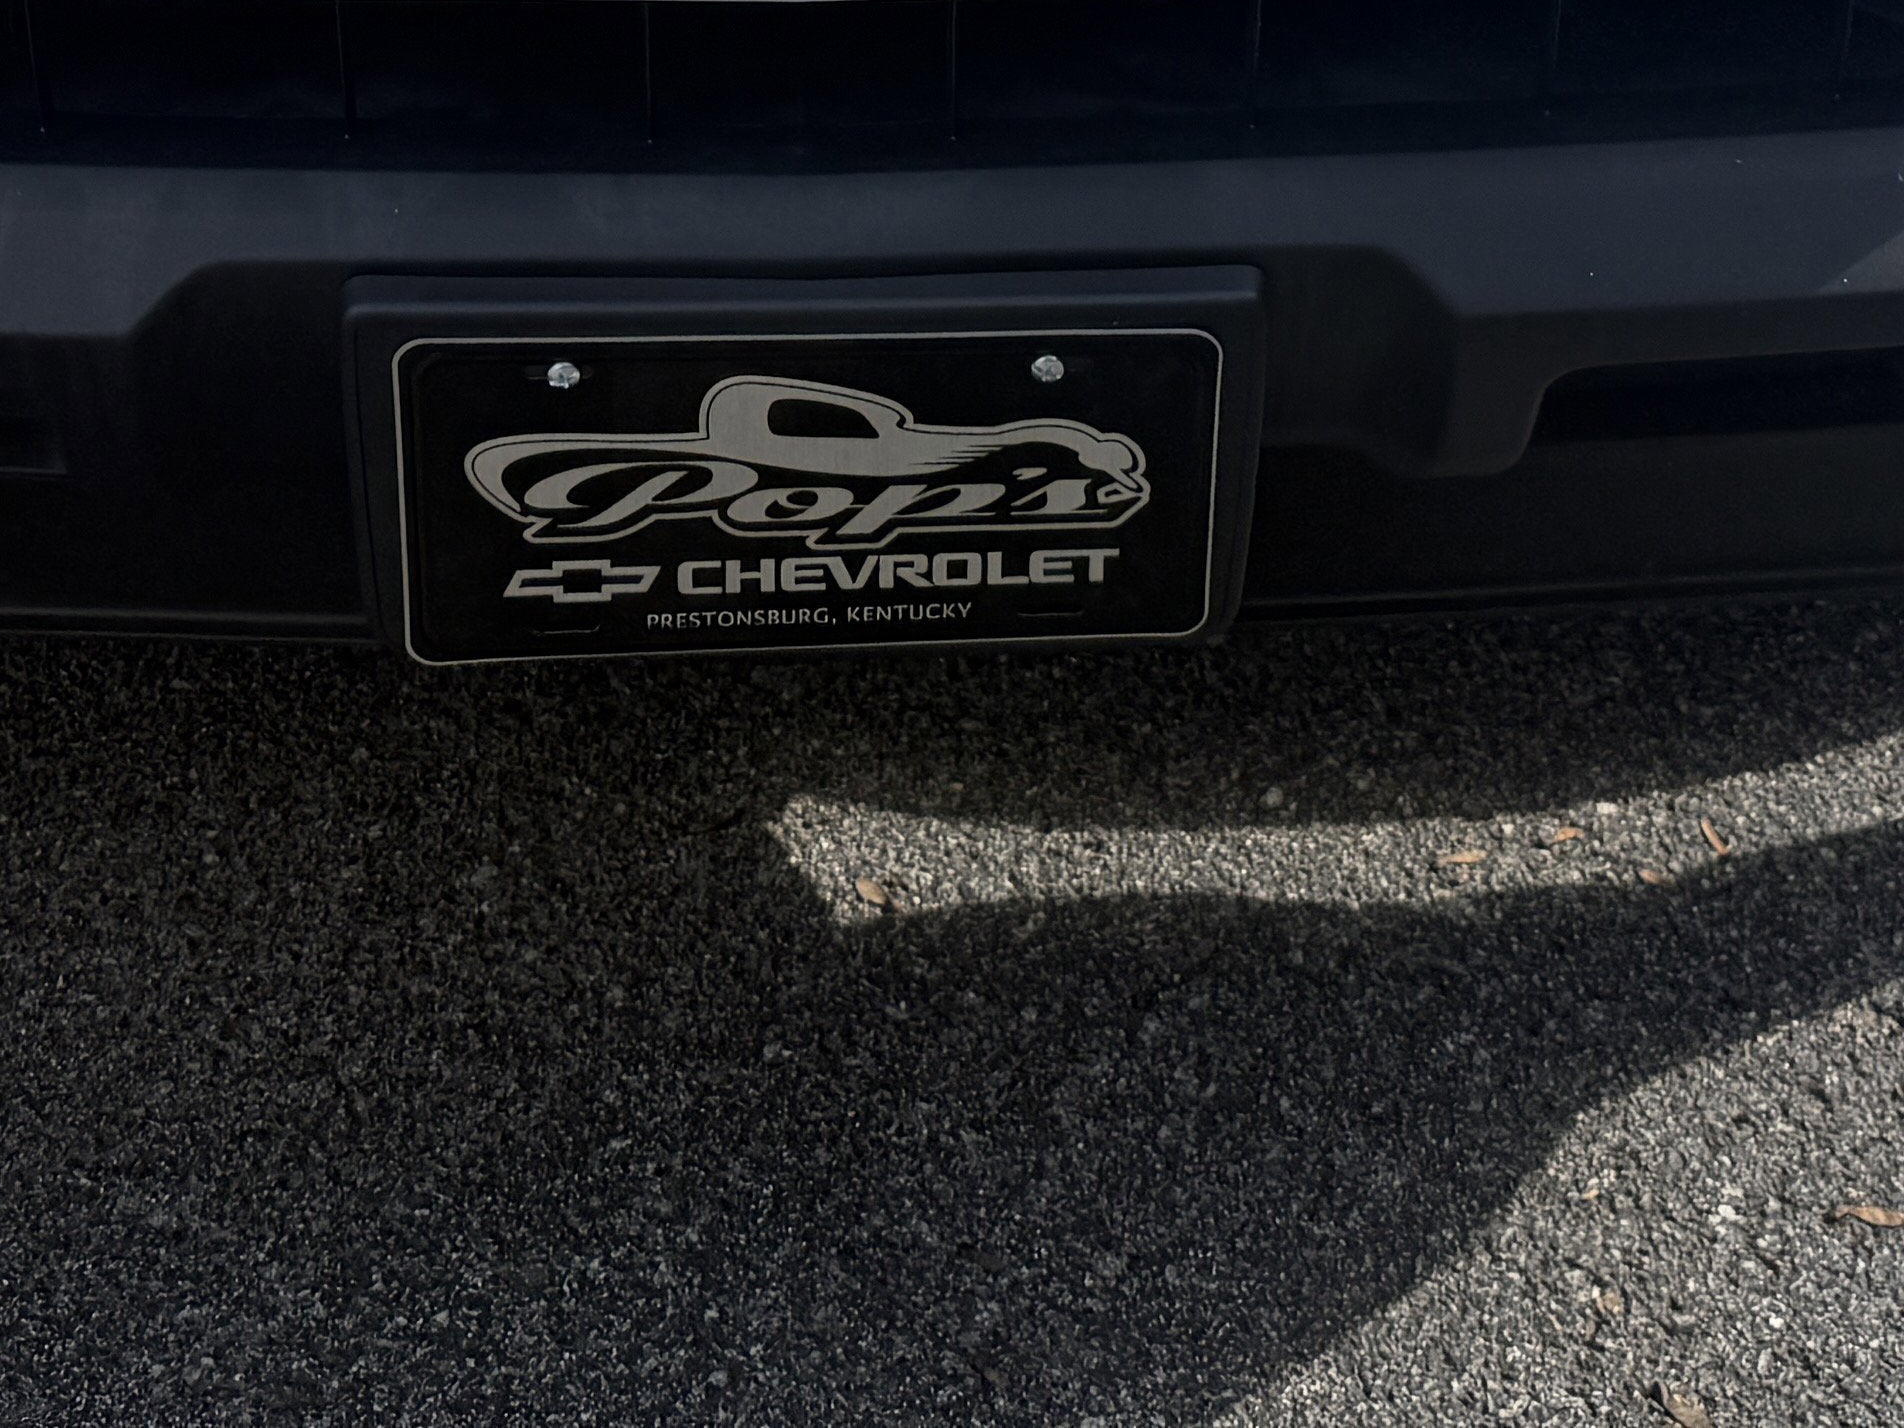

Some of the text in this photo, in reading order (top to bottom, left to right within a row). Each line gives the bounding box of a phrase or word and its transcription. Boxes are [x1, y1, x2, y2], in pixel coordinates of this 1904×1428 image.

[524, 460, 1108, 536] Pop's
[677, 547, 1120, 595] CHEVROLET
[647, 601, 973, 631] PRESTONSBURG, KENTUCKY
